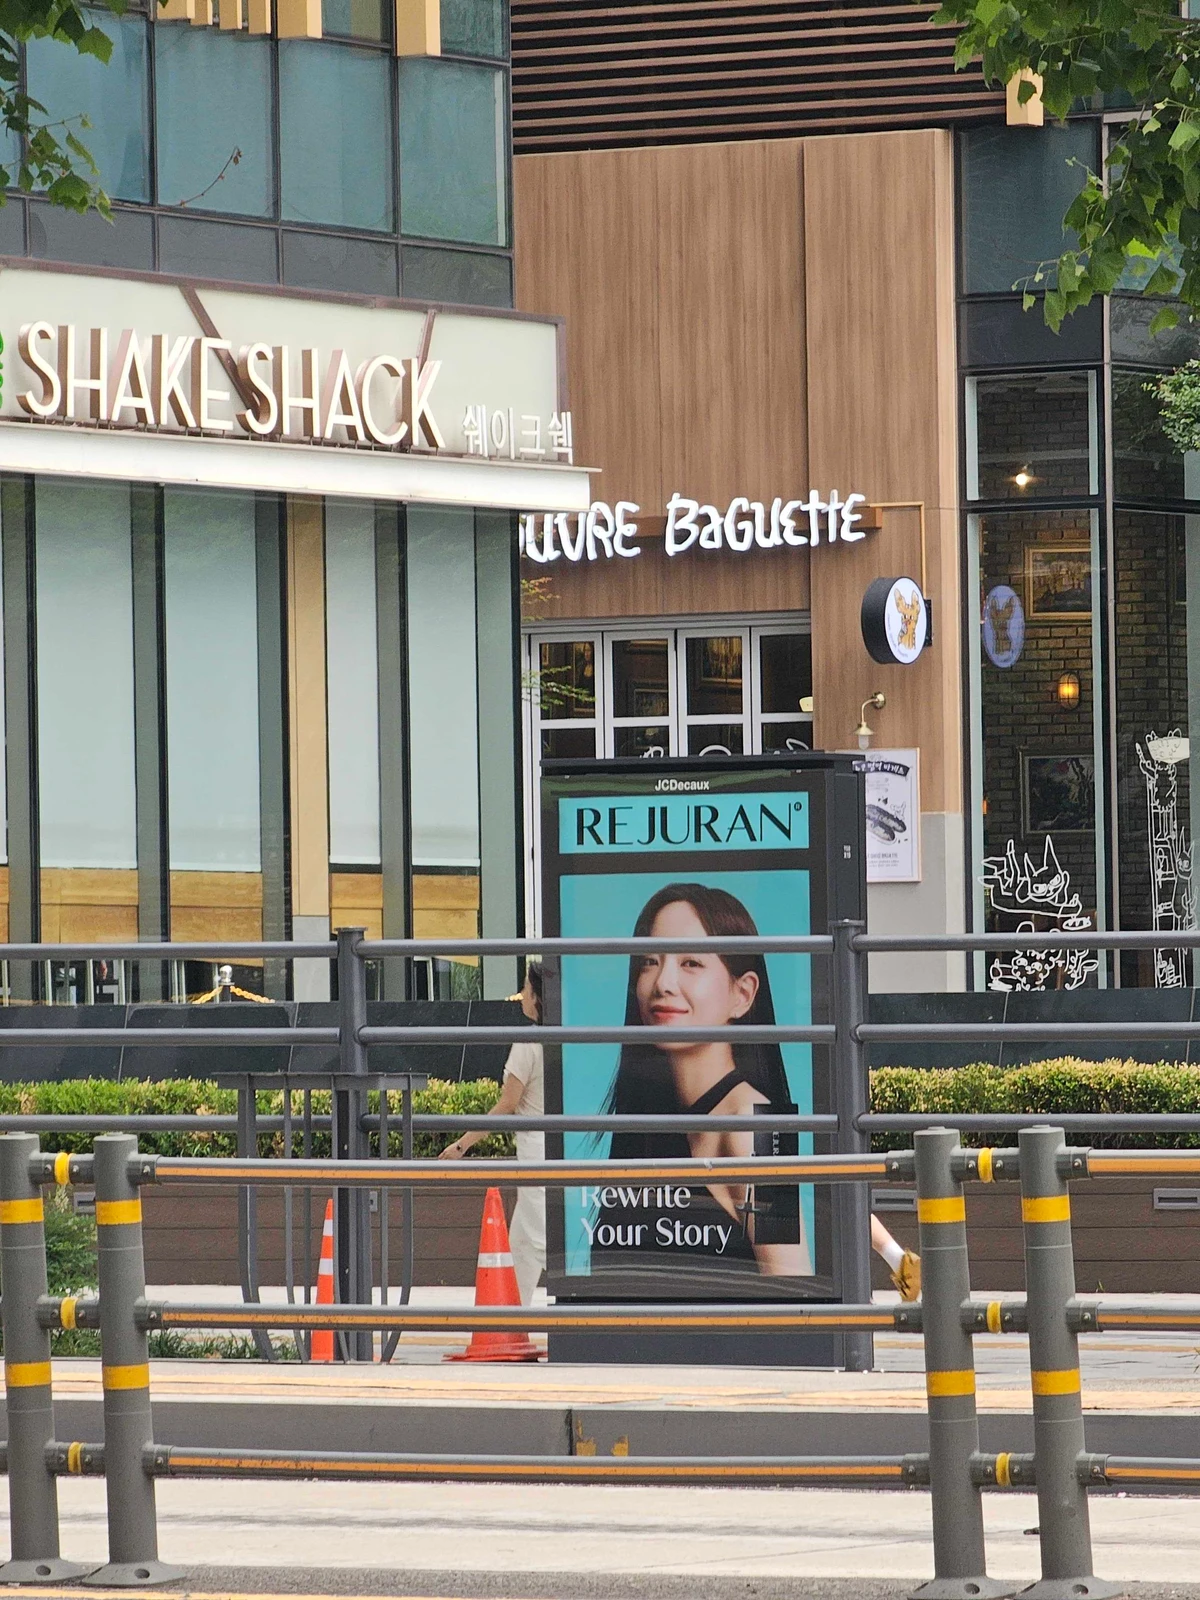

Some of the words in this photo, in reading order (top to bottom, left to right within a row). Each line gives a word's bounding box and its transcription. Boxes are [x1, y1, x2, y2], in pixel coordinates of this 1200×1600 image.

[518, 501, 641, 563] UVRE
[654, 779, 710, 791] JCDecaux
[580, 1185, 692, 1208] Rewrite
[580, 1217, 649, 1246] Your
[655, 1217, 733, 1254] Story
